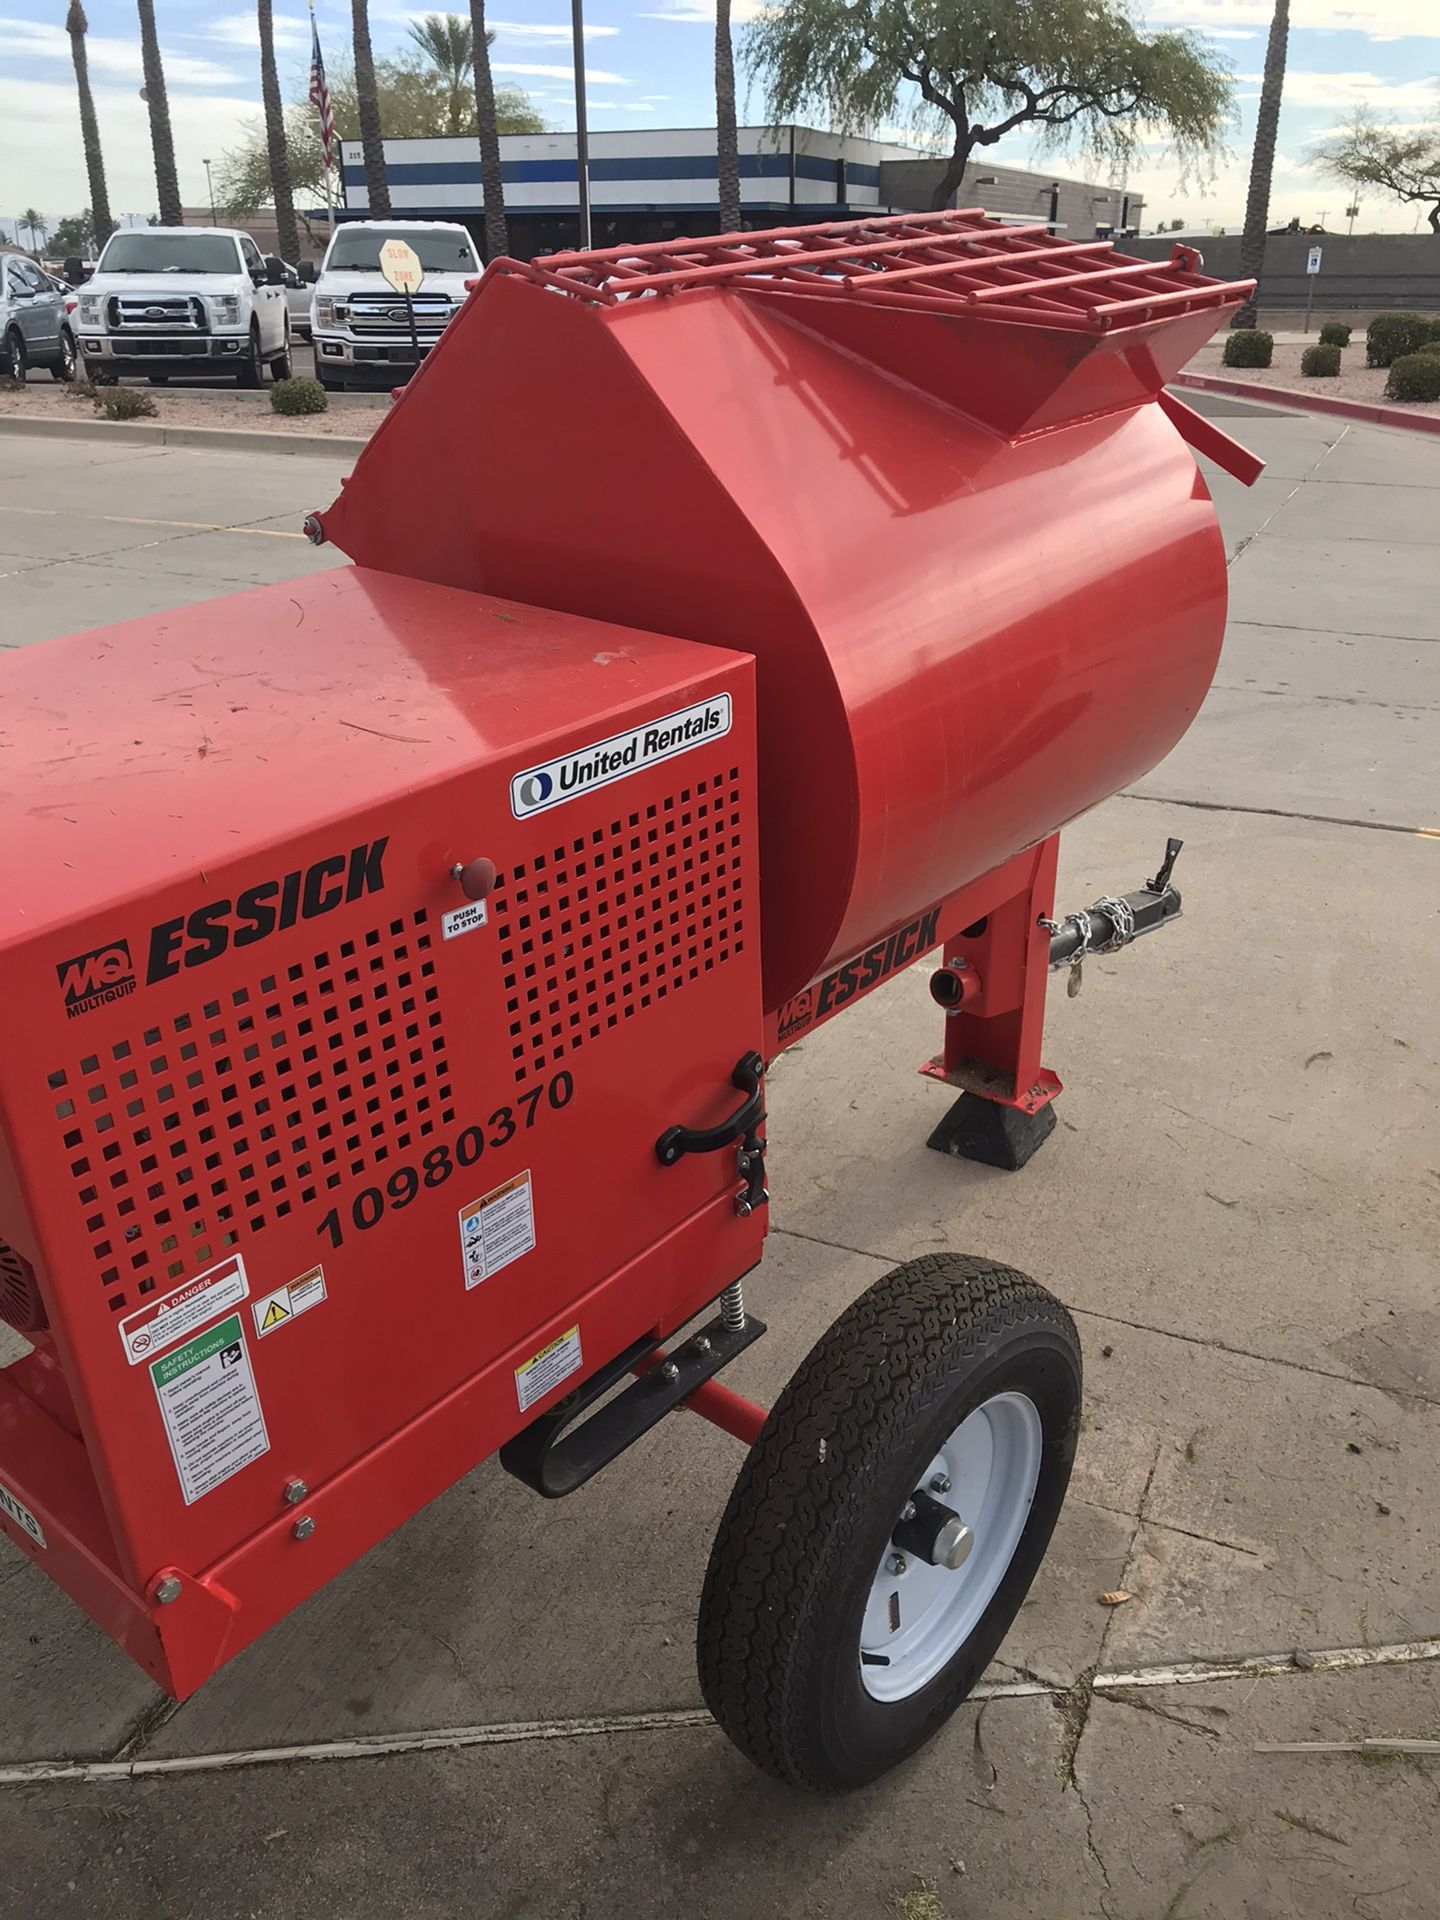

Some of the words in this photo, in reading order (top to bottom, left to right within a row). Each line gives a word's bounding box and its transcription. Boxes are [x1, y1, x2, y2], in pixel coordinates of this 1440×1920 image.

[386, 248, 410, 259] SLOW
[393, 270, 414, 281] ZONE
[559, 737, 638, 791] United
[642, 707, 721, 758] Rentals
[56, 937, 136, 1007] MQ
[146, 835, 390, 987] ESSICK
[447, 923, 460, 933] TO
[461, 913, 484, 928] STOP
[453, 906, 477, 922] PUSH
[815, 905, 943, 1019] ESSICK
[66, 980, 137, 1020] MULTIQUIP
[316, 1070, 575, 1250] 10980370
[171, 1278, 213, 1307] DANGER
[160, 1347, 194, 1372] SAFETY
[162, 1338, 225, 1380] INSTRUCTIONS
[538, 1338, 565, 1360] CAUTION
